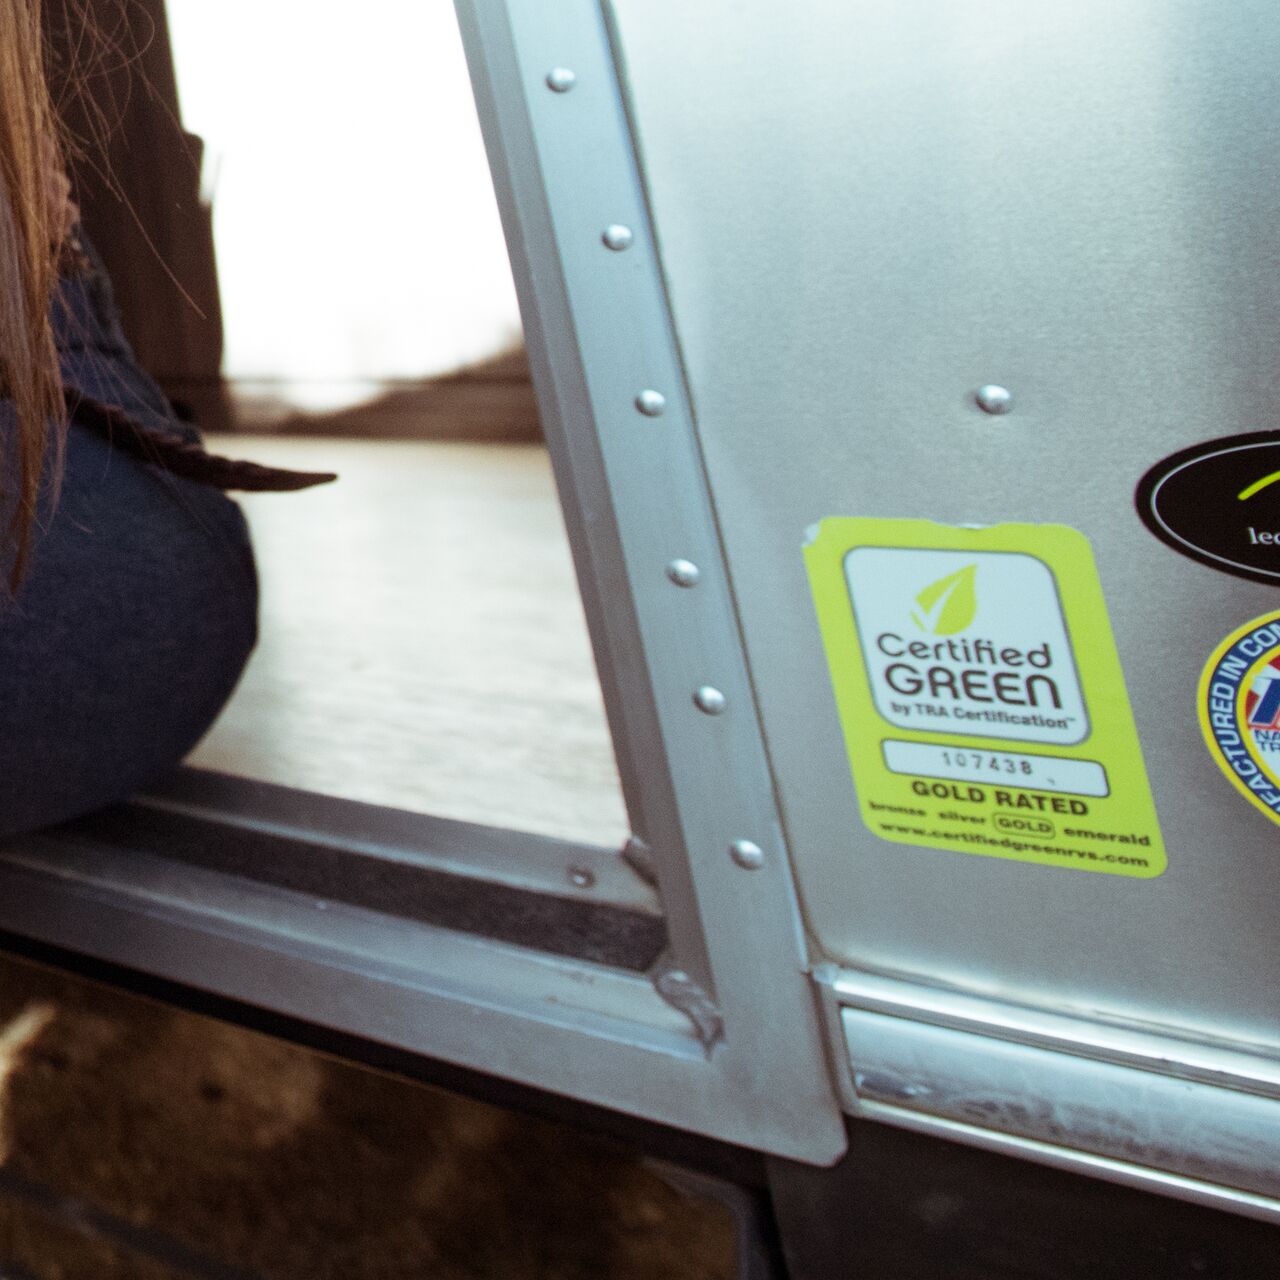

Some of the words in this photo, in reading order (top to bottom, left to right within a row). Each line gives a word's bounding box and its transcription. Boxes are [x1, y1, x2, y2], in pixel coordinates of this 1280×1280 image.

[877, 632, 1053, 669] Certified
[1220, 654, 1248, 681] IN
[885, 663, 1062, 709] GREEN
[891, 702, 911, 716] by
[915, 703, 949, 718] TRA
[942, 751, 1033, 776] 107438
[1211, 684, 1280, 813] FACTURED
[912, 781, 986, 804] GOLD
[994, 790, 1090, 816] RATED
[879, 821, 1150, 869] www.certifiedgreenrvs.com
[997, 817, 1053, 834] GOLD
[1063, 827, 1151, 847] emerald
